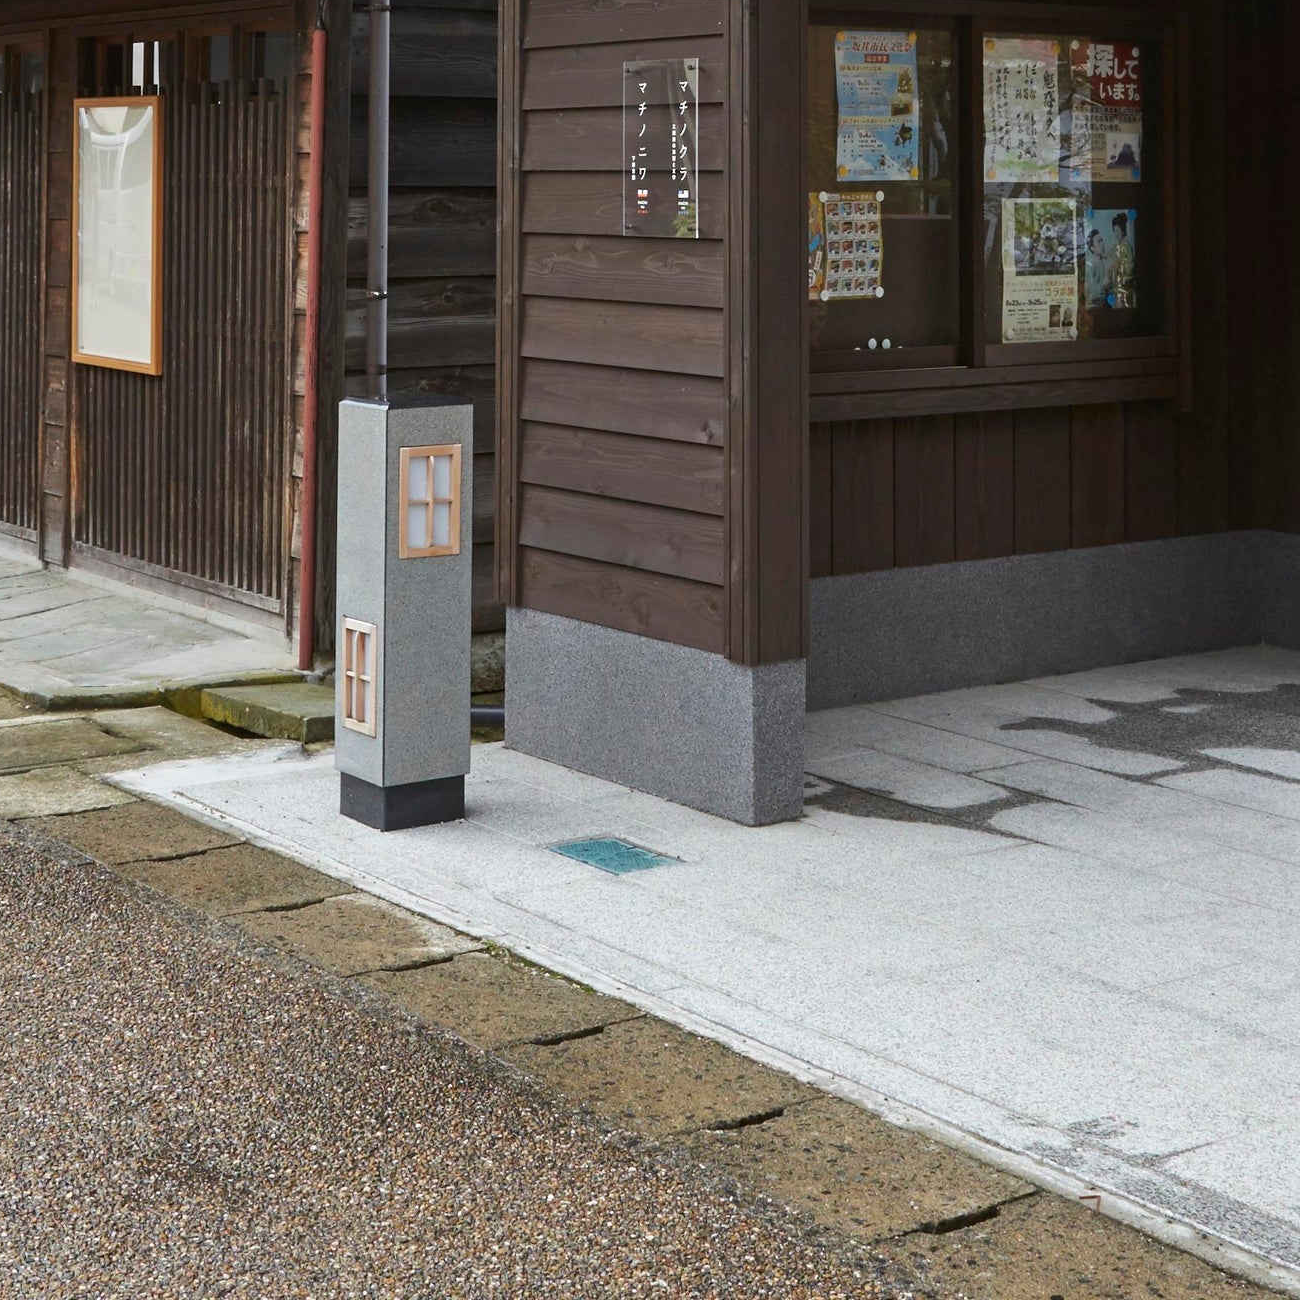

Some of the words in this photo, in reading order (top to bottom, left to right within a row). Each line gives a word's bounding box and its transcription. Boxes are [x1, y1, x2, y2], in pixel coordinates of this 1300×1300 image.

[1087, 44, 1139, 79] 探して
[1099, 82, 1140, 101] います。
[638, 82, 647, 181] マチノニワ
[679, 81, 688, 181] マチノクラ
